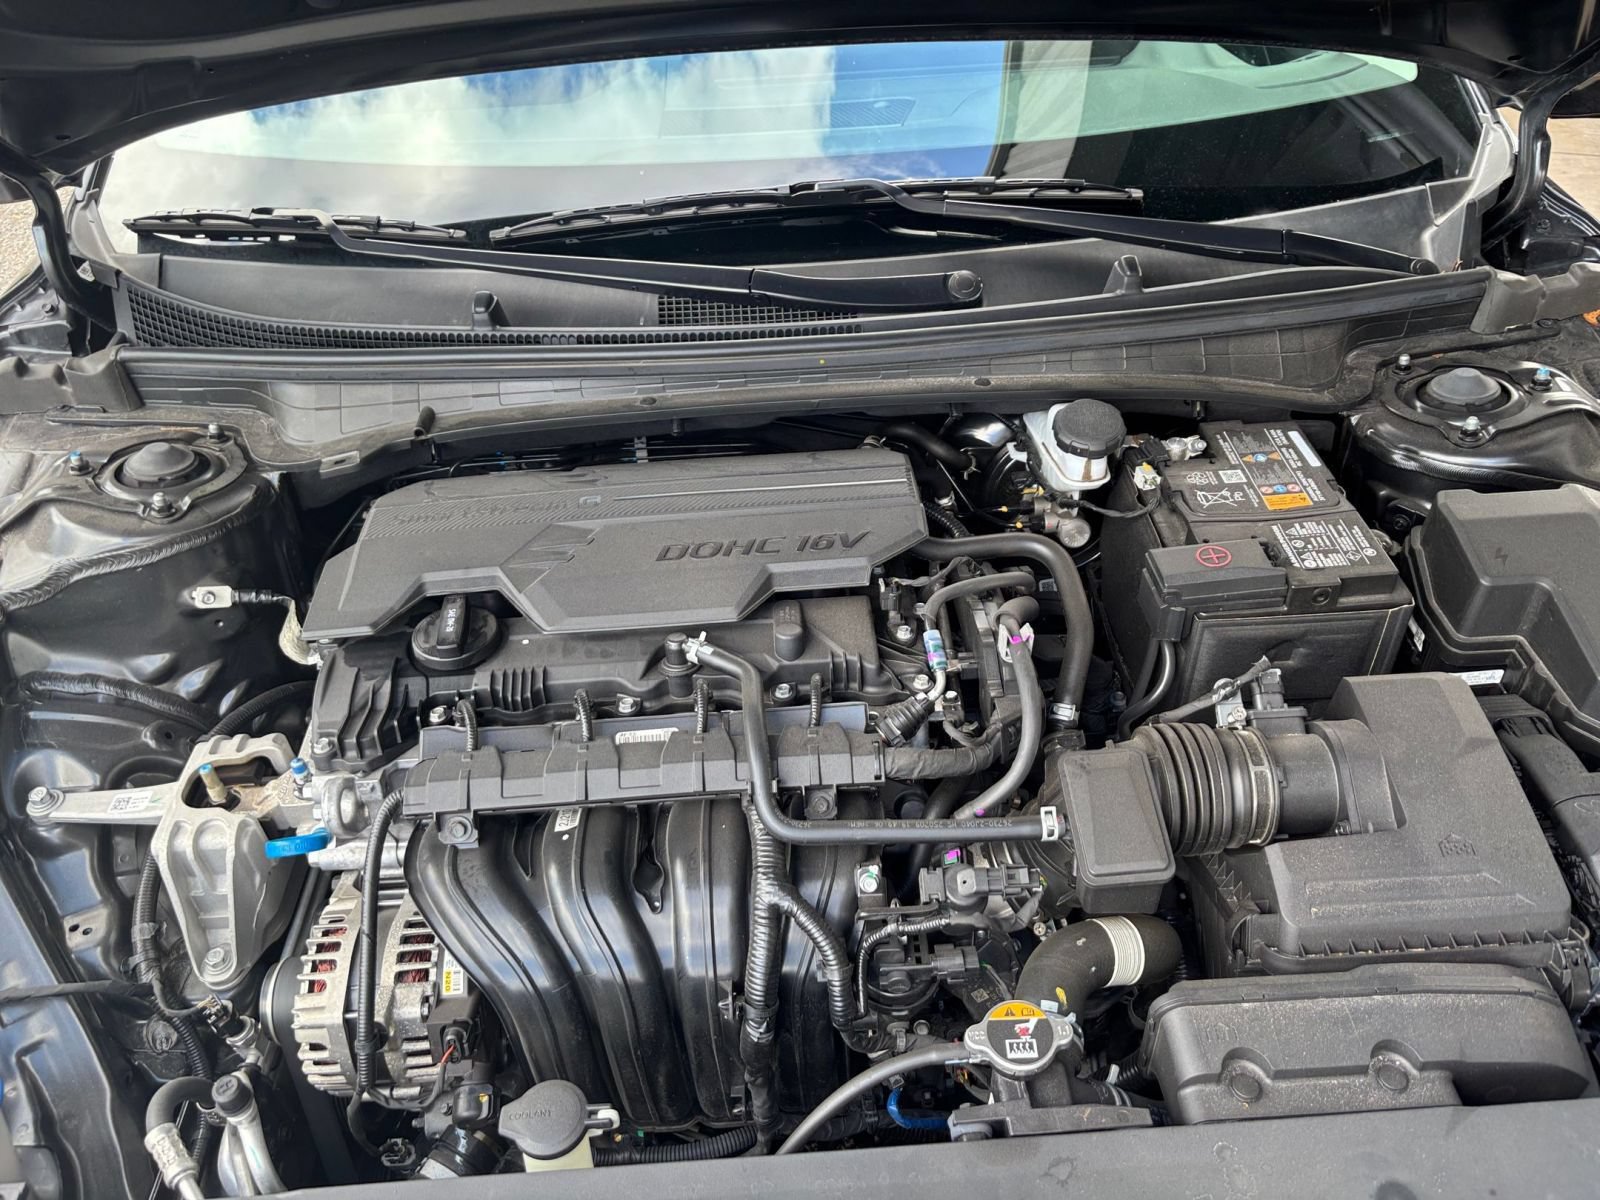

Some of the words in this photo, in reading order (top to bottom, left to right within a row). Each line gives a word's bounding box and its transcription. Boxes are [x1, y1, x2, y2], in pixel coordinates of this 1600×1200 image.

[655, 536, 787, 562] DOHC
[796, 529, 871, 553] 16V
[1056, 1024, 1071, 1036] 1.1
[508, 1109, 551, 1121] COOLANT
